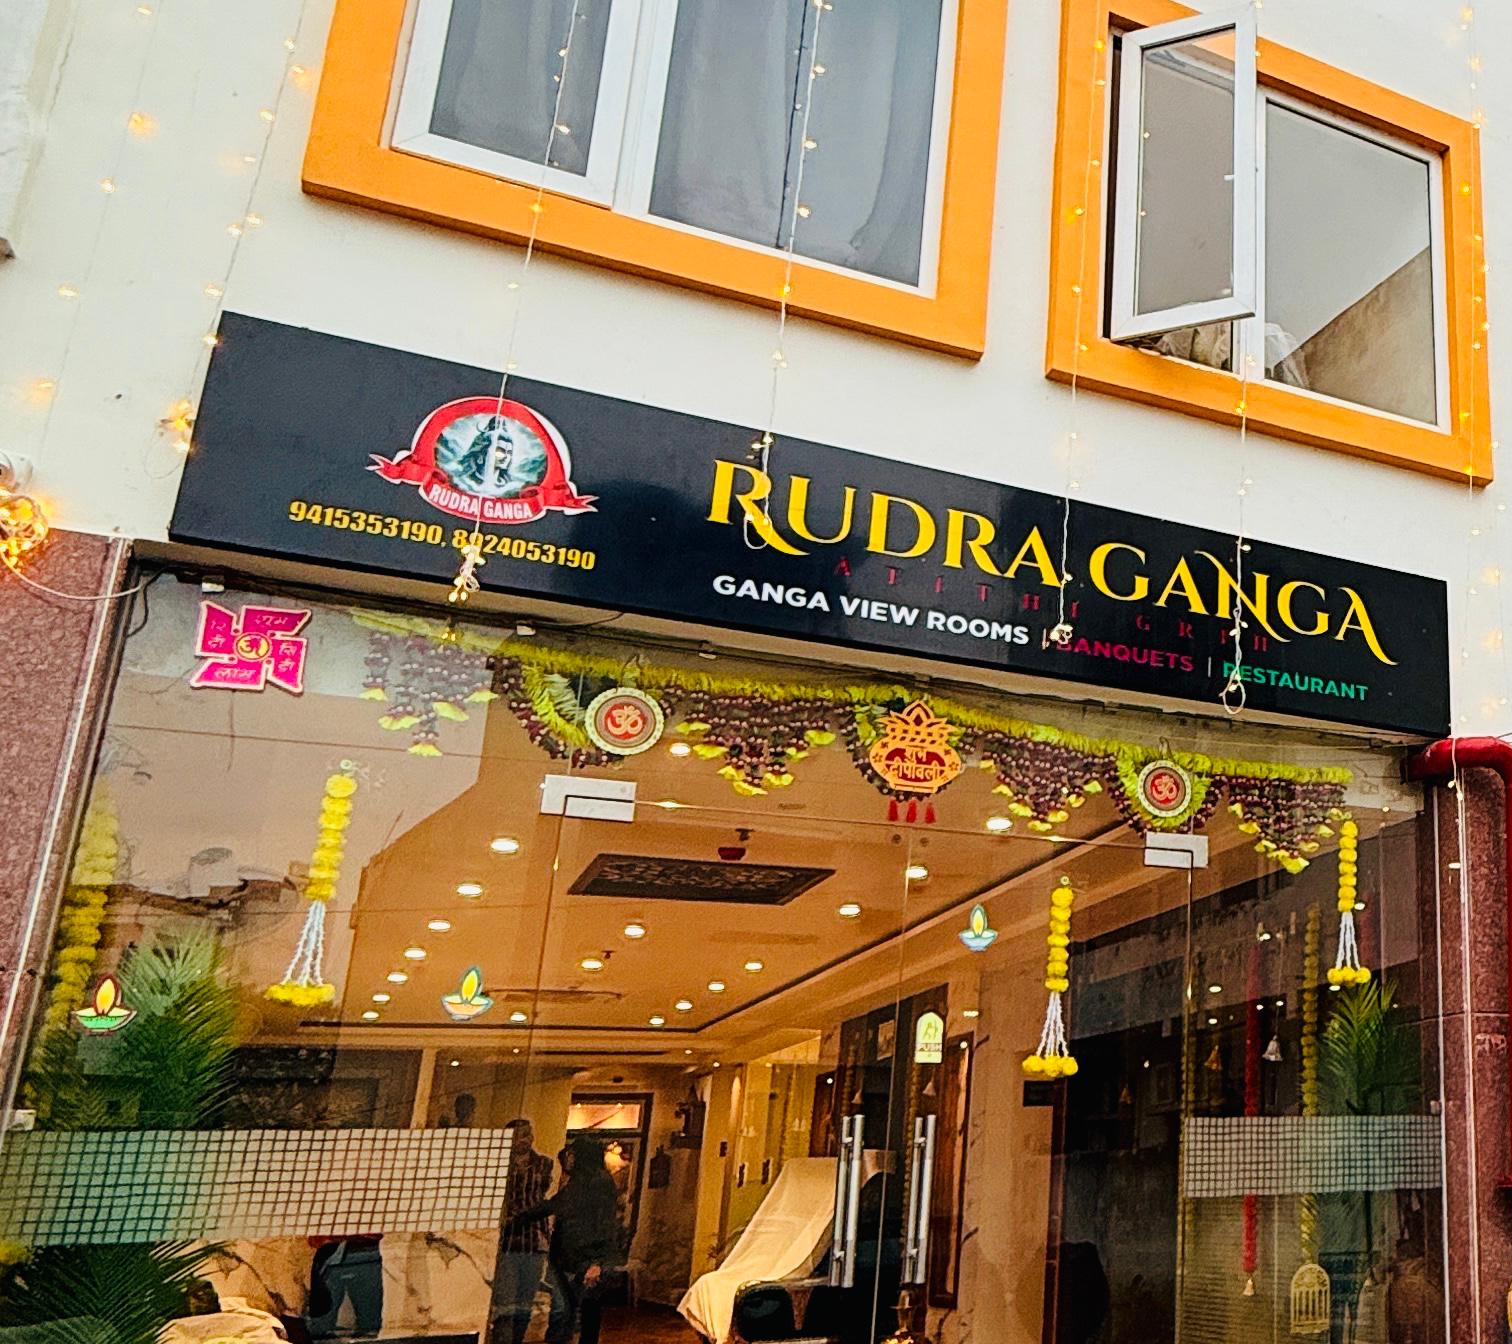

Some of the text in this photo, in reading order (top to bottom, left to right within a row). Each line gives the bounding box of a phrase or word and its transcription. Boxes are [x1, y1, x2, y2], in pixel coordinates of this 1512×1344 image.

[288, 500, 447, 548] 9415353190,
[429, 483, 534, 520] RUDRA GANGA
[706, 459, 1400, 666] RUDRA GANGA
[712, 574, 831, 613] GANGA
[838, 595, 922, 627] VIEW
[926, 611, 1030, 646] ROOMS
[1222, 659, 1369, 702] RESTAURANT
